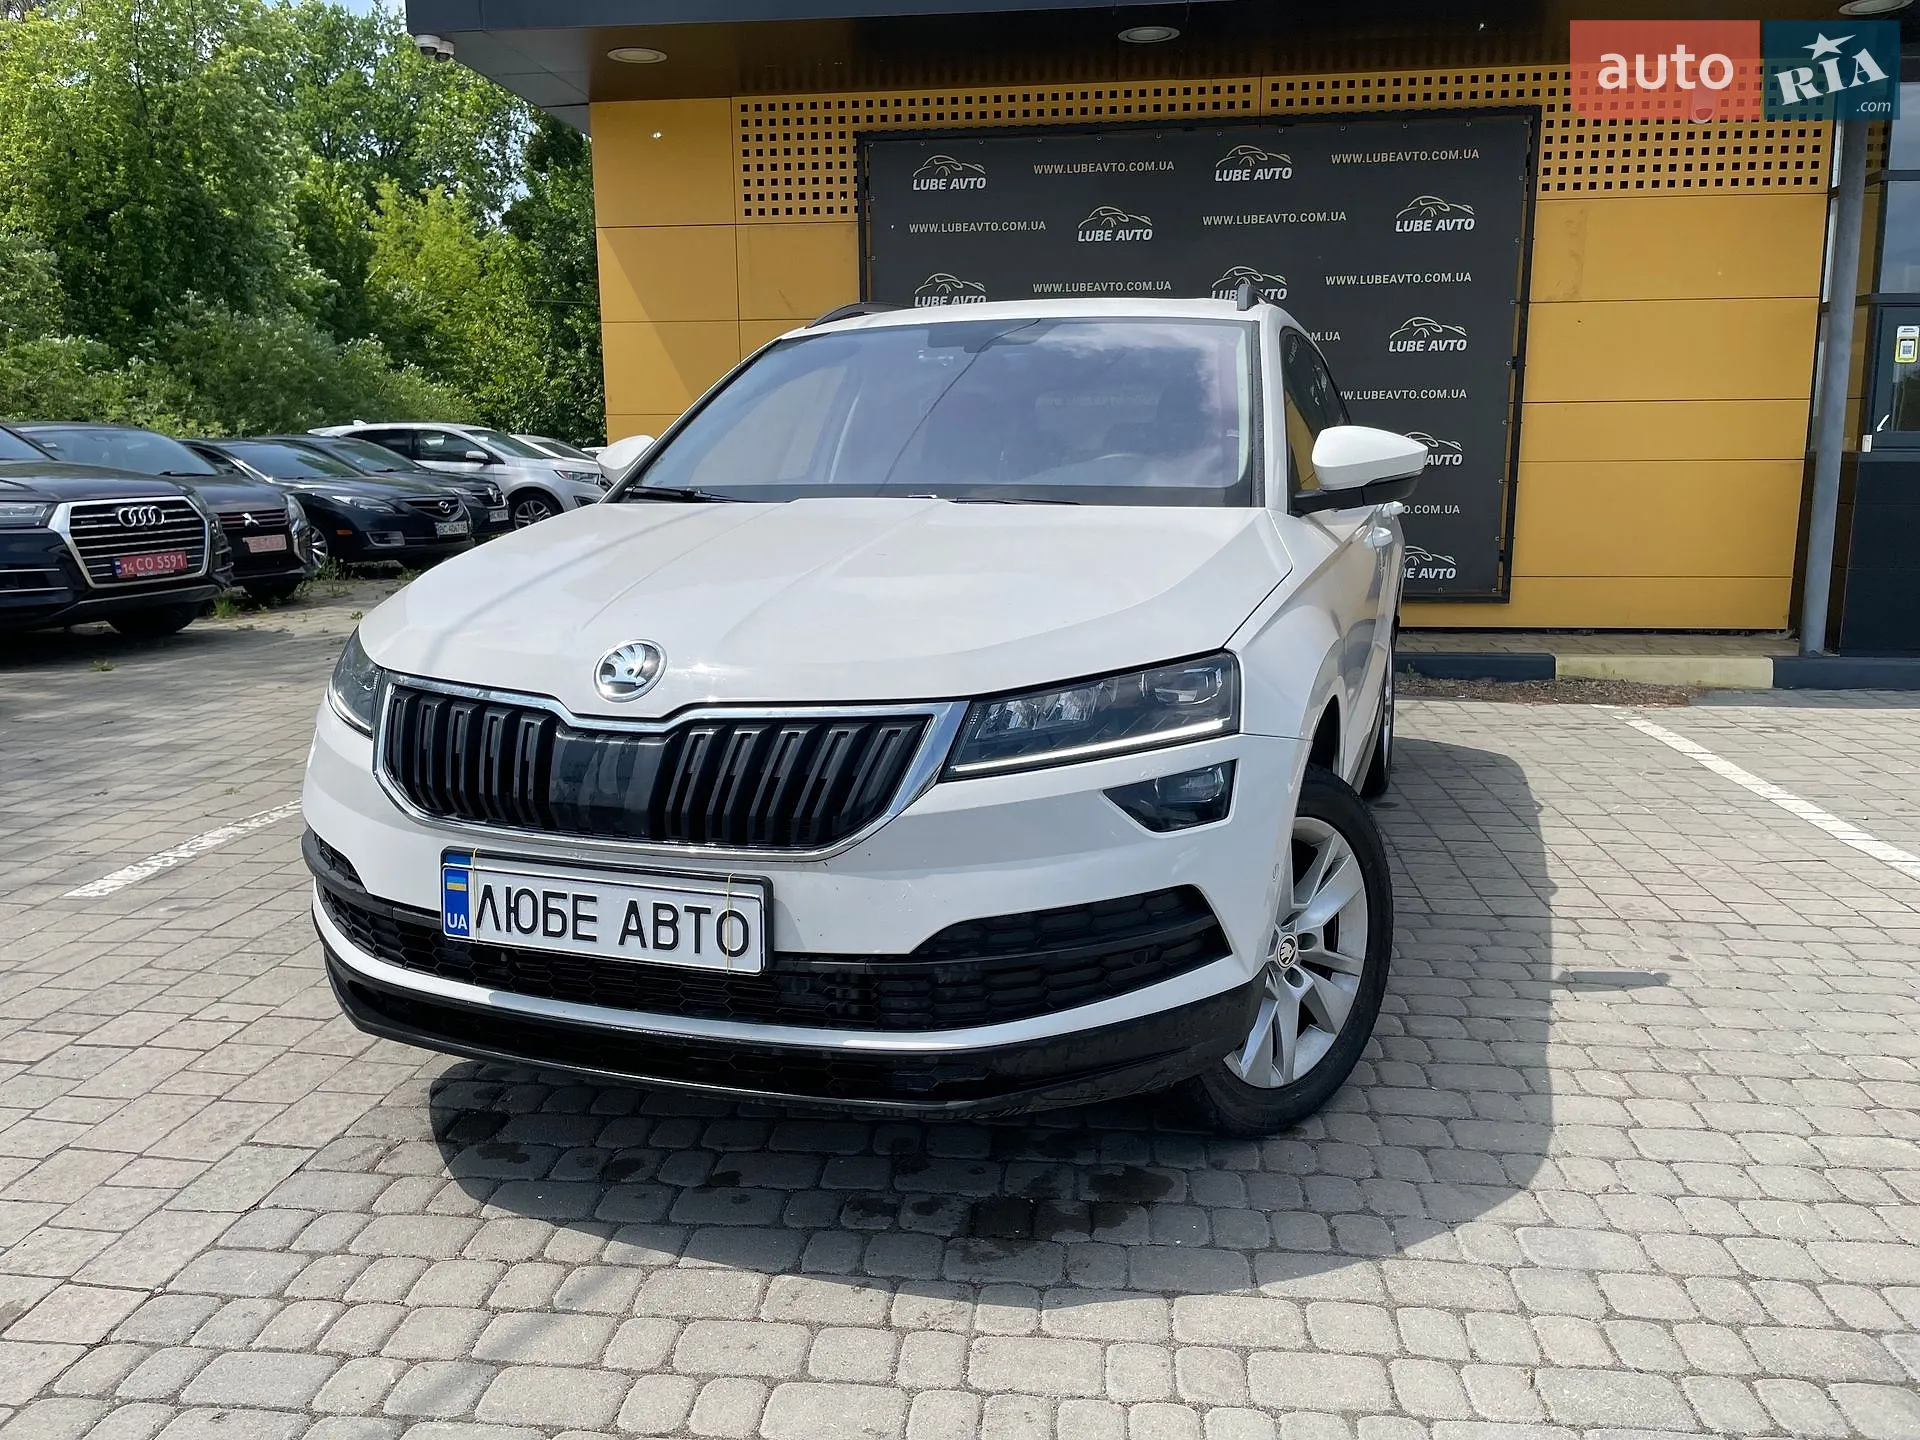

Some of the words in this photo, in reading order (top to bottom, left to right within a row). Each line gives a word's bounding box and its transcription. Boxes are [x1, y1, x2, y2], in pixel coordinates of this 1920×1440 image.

[1332, 149, 1479, 163] WWW.LUBEAVTO.COM.UA
[1034, 162, 1174, 173] WWW.LUBEAVTO.COM.UA
[1215, 170, 1251, 181] LUBE
[1253, 167, 1293, 180] AVTO
[913, 179, 946, 190] LUBE
[950, 178, 986, 189] AVTO
[1203, 212, 1346, 225] WWW.LUBEAVTO.COM.UA
[910, 221, 1045, 232] WWW.LUBEAVTO.COM.UA
[1396, 220, 1432, 232] LUBE
[1435, 219, 1474, 231] AVTO
[1078, 230, 1112, 241] LUBE
[1115, 229, 1152, 240] AVTO
[1326, 273, 1471, 285] WWW.LUBEAVTO.COM.UA
[1033, 281, 1171, 292] WWW.LUBEAVTO.COM.UA
[1212, 290, 1238, 299] LUB
[1260, 288, 1287, 300] VTO
[914, 296, 948, 307] LUBE
[1389, 341, 1425, 352] LUBE
[1428, 340, 1467, 351] AVTO
[1341, 389, 1467, 401] W.LUBEAVTO.COM.UA
[1425, 454, 1463, 465] AVTO
[136, 557, 153, 571] CO
[157, 554, 184, 569] 5591
[1419, 568, 1456, 579] AVTO
[447, 913, 468, 930] UA
[477, 884, 598, 942] ЛЮБЕ
[618, 900, 750, 957] АВТО
